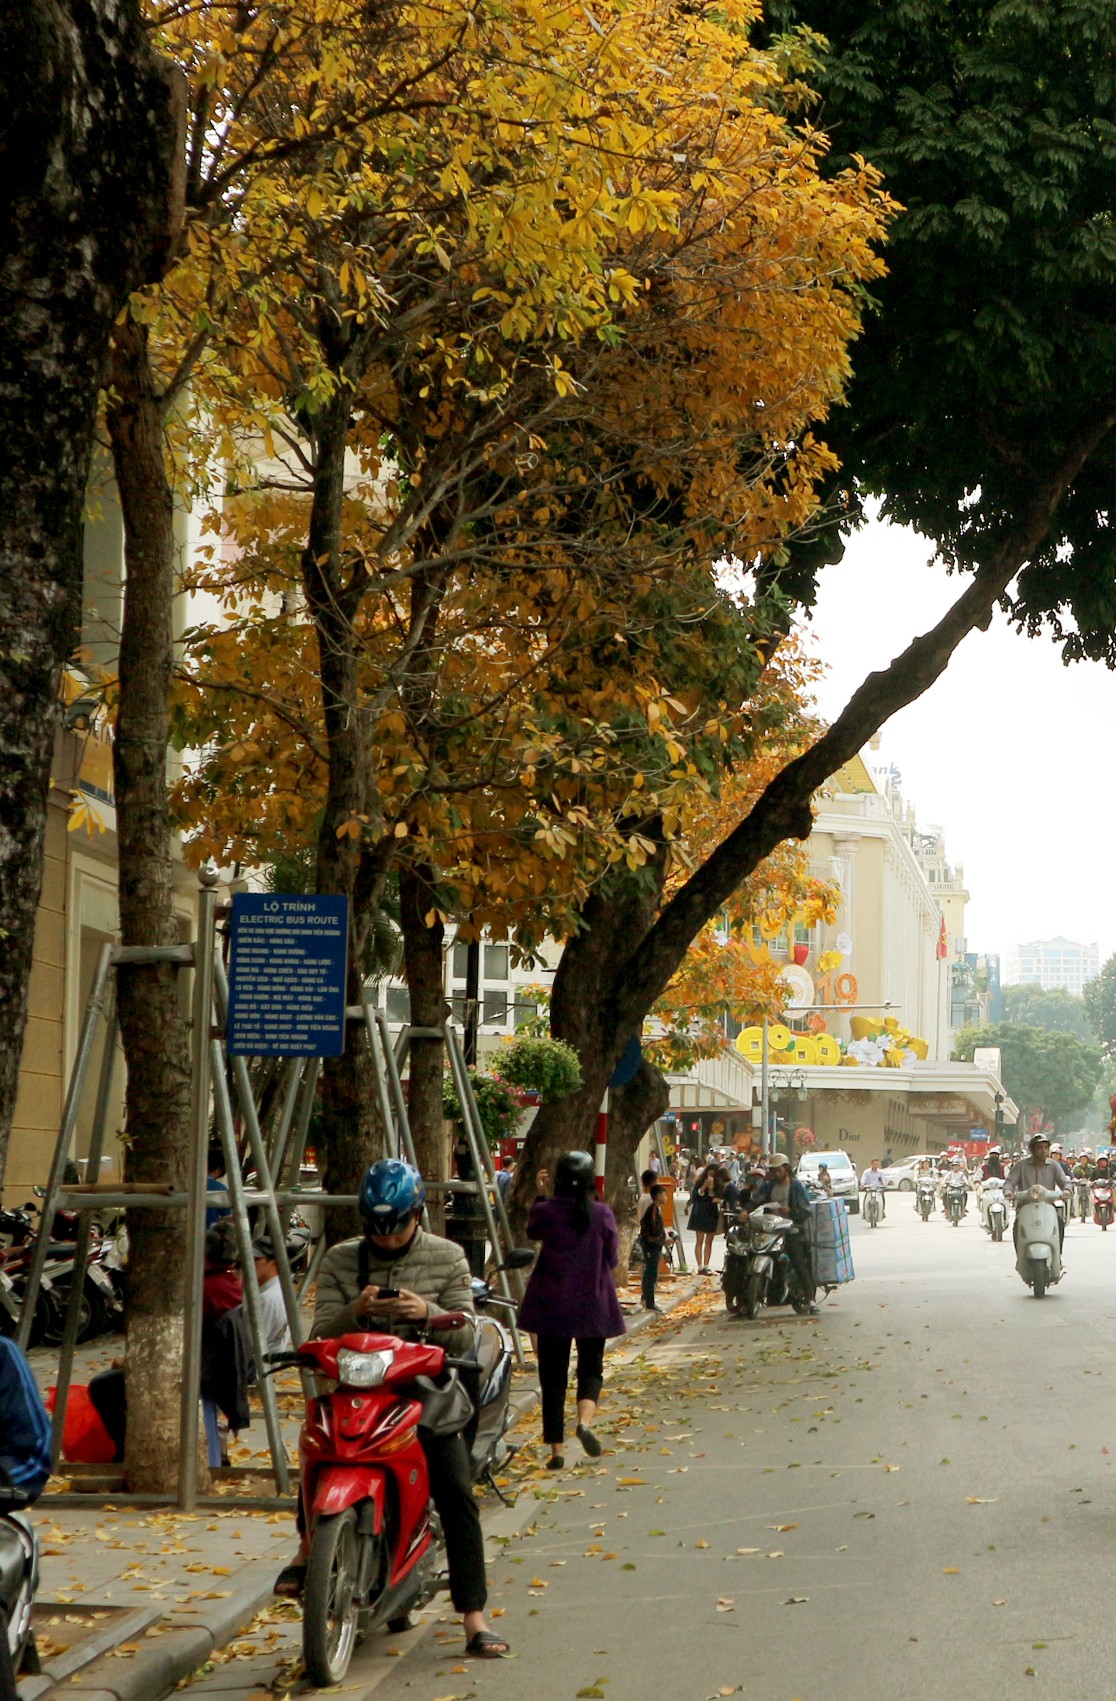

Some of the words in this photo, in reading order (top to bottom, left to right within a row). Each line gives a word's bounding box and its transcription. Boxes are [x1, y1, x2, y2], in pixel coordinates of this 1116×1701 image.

[239, 914, 284, 924] ELECTRIC
[286, 915, 305, 925] BUS
[306, 915, 339, 925] ROUTE
[839, 1127, 862, 1142] Dior
